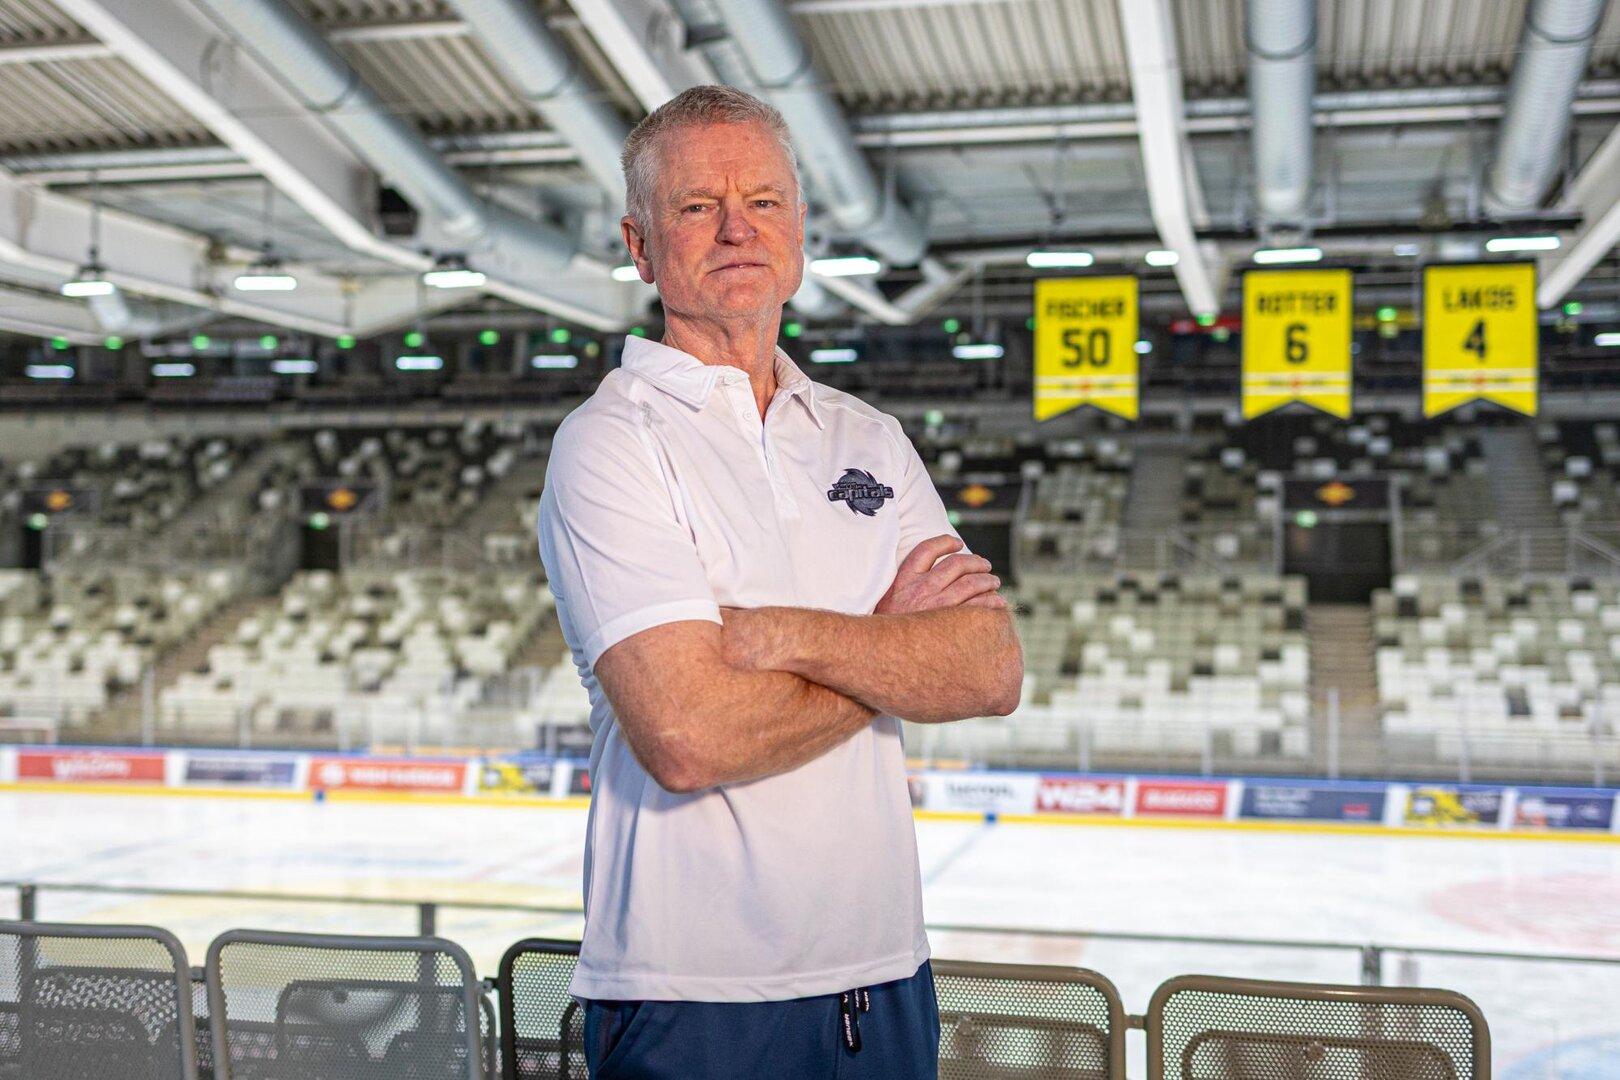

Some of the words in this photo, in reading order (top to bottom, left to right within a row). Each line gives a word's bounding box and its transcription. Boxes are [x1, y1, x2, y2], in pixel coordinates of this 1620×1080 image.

[1046, 298, 1124, 319] FISCHER
[1061, 327, 1110, 368] 50
[1284, 322, 1309, 364] 6
[1462, 317, 1487, 360] 4
